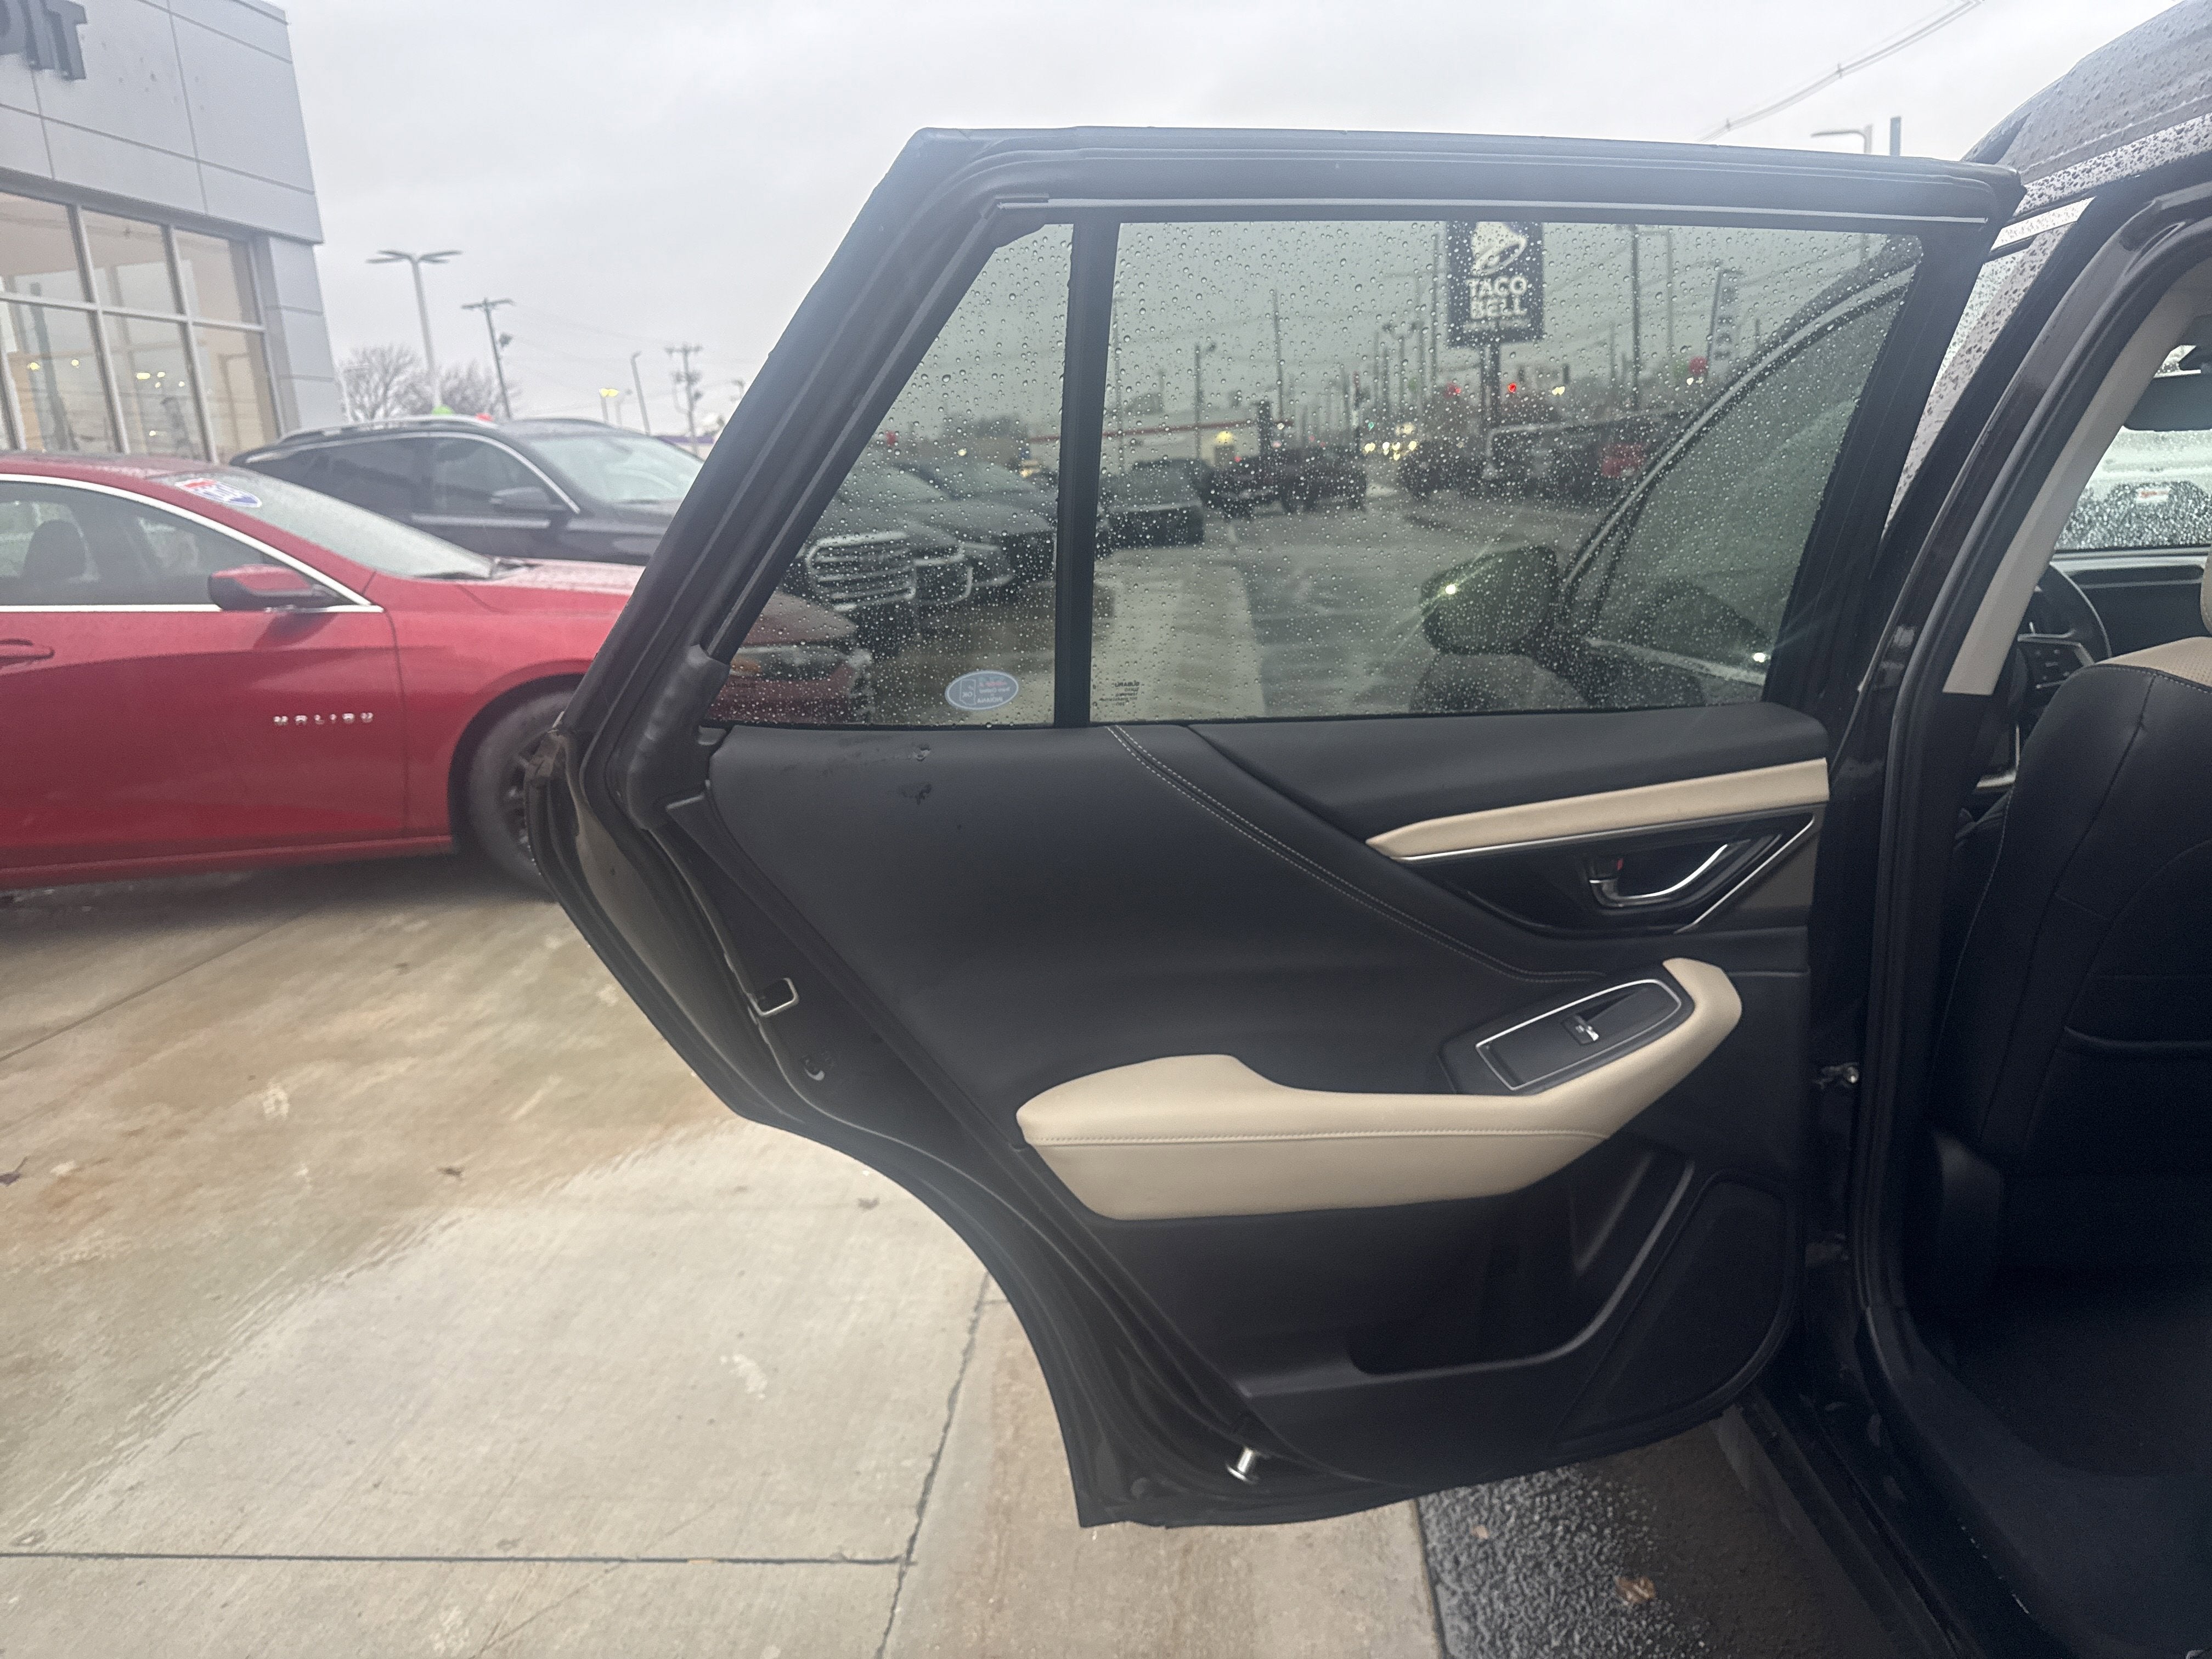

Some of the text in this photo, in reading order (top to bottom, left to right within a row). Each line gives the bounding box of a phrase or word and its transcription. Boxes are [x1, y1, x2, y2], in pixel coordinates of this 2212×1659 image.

[1465, 275, 1528, 297] TACO
[1470, 296, 1527, 319] BELL
[273, 712, 374, 726] MALIBU
